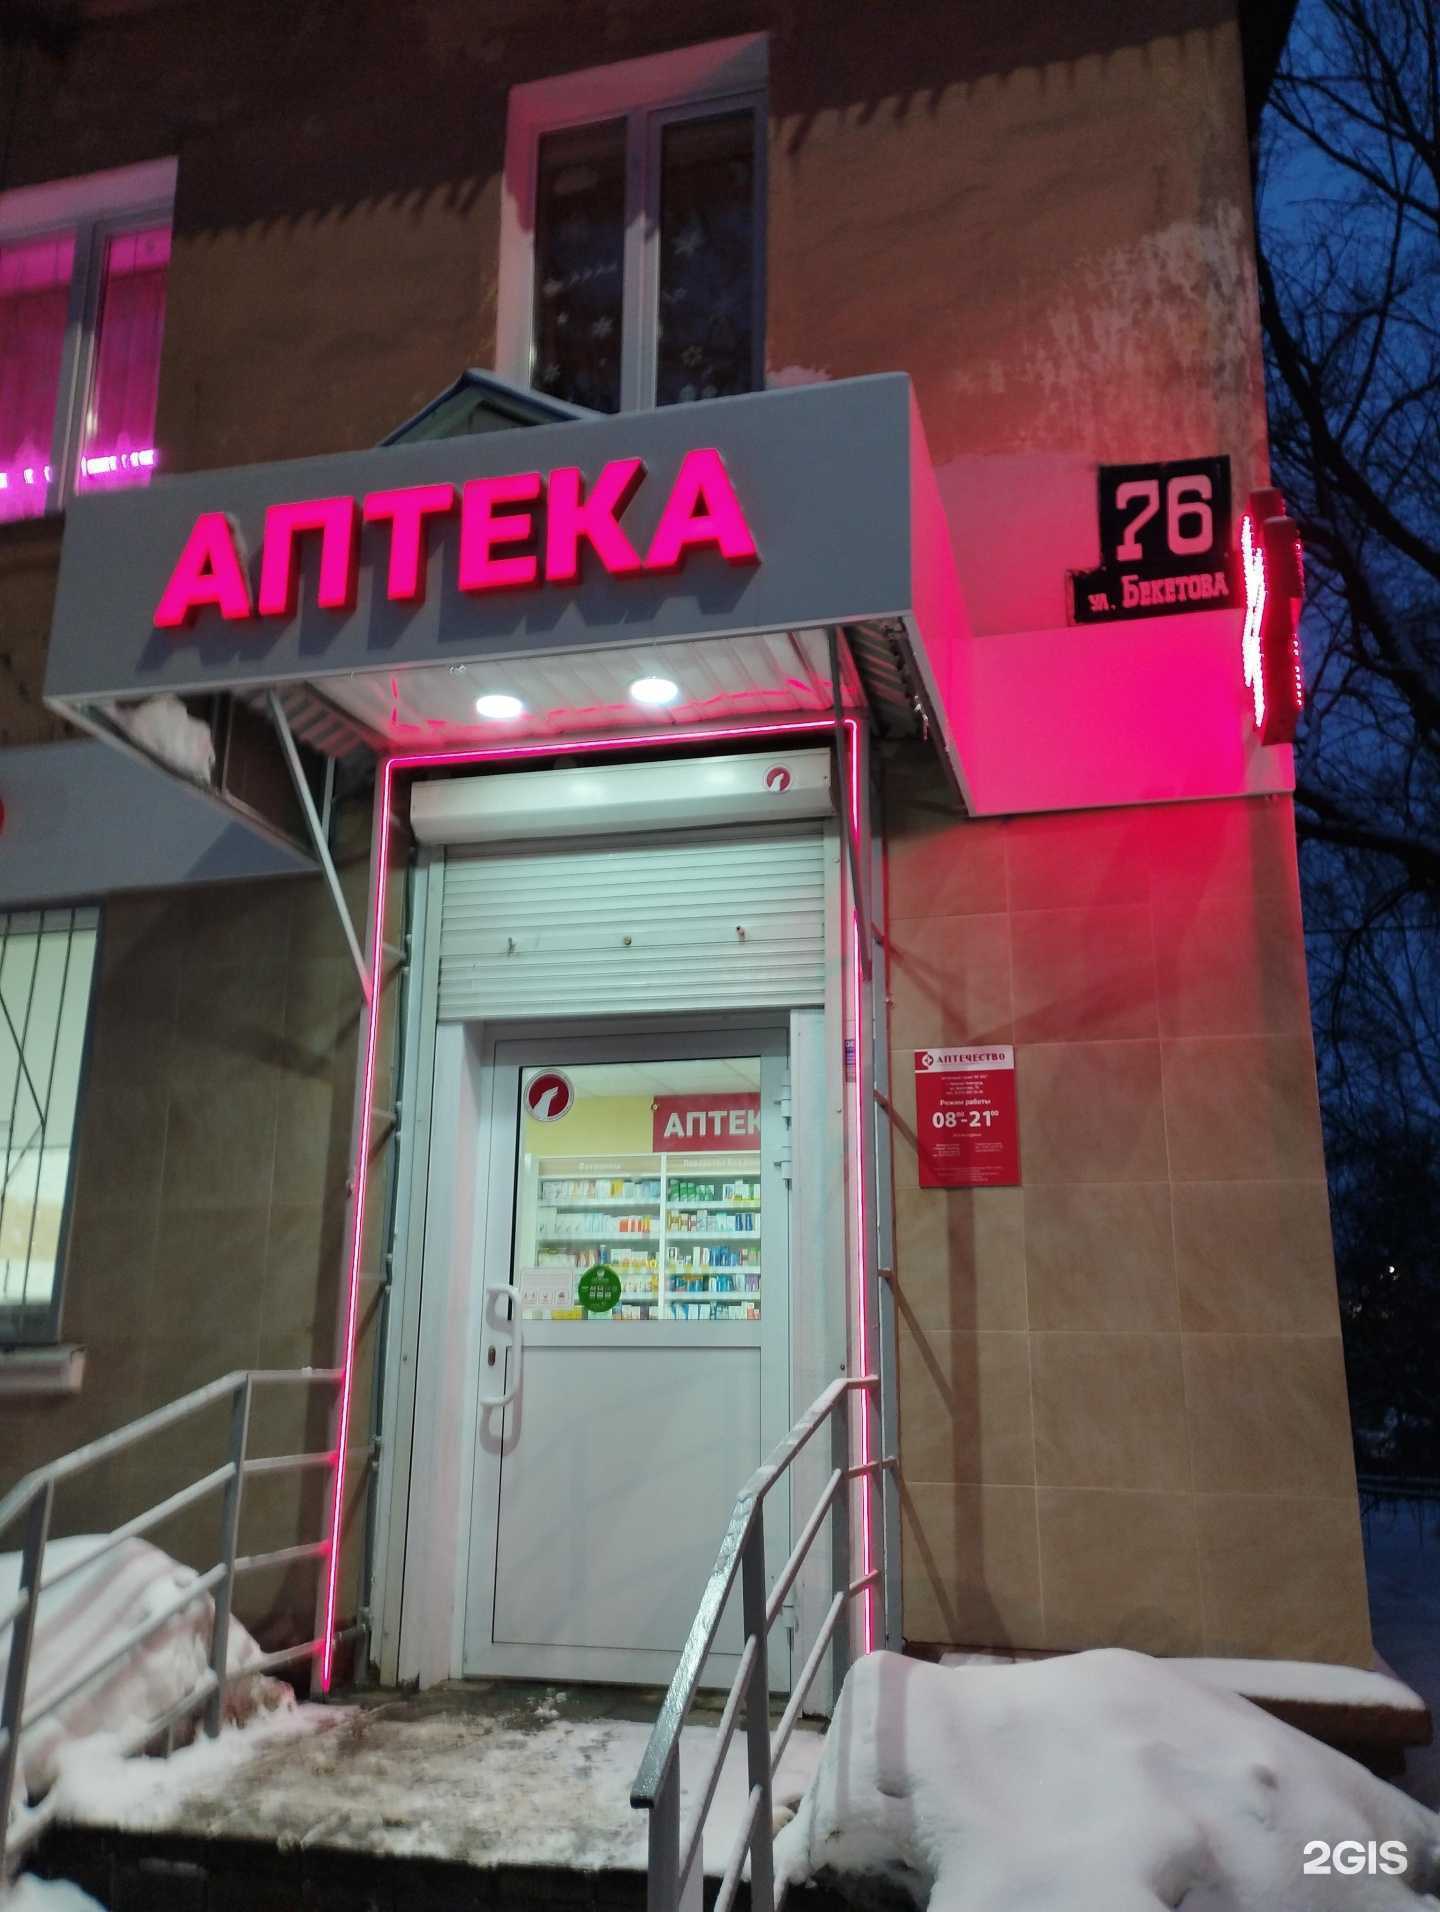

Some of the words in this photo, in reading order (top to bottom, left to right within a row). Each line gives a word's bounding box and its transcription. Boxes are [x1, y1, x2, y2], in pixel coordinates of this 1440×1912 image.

[154, 448, 758, 627] АПТЕКА
[1115, 475, 1213, 562] 76
[937, 1053, 1005, 1063] АПТЕЧЕСТВО
